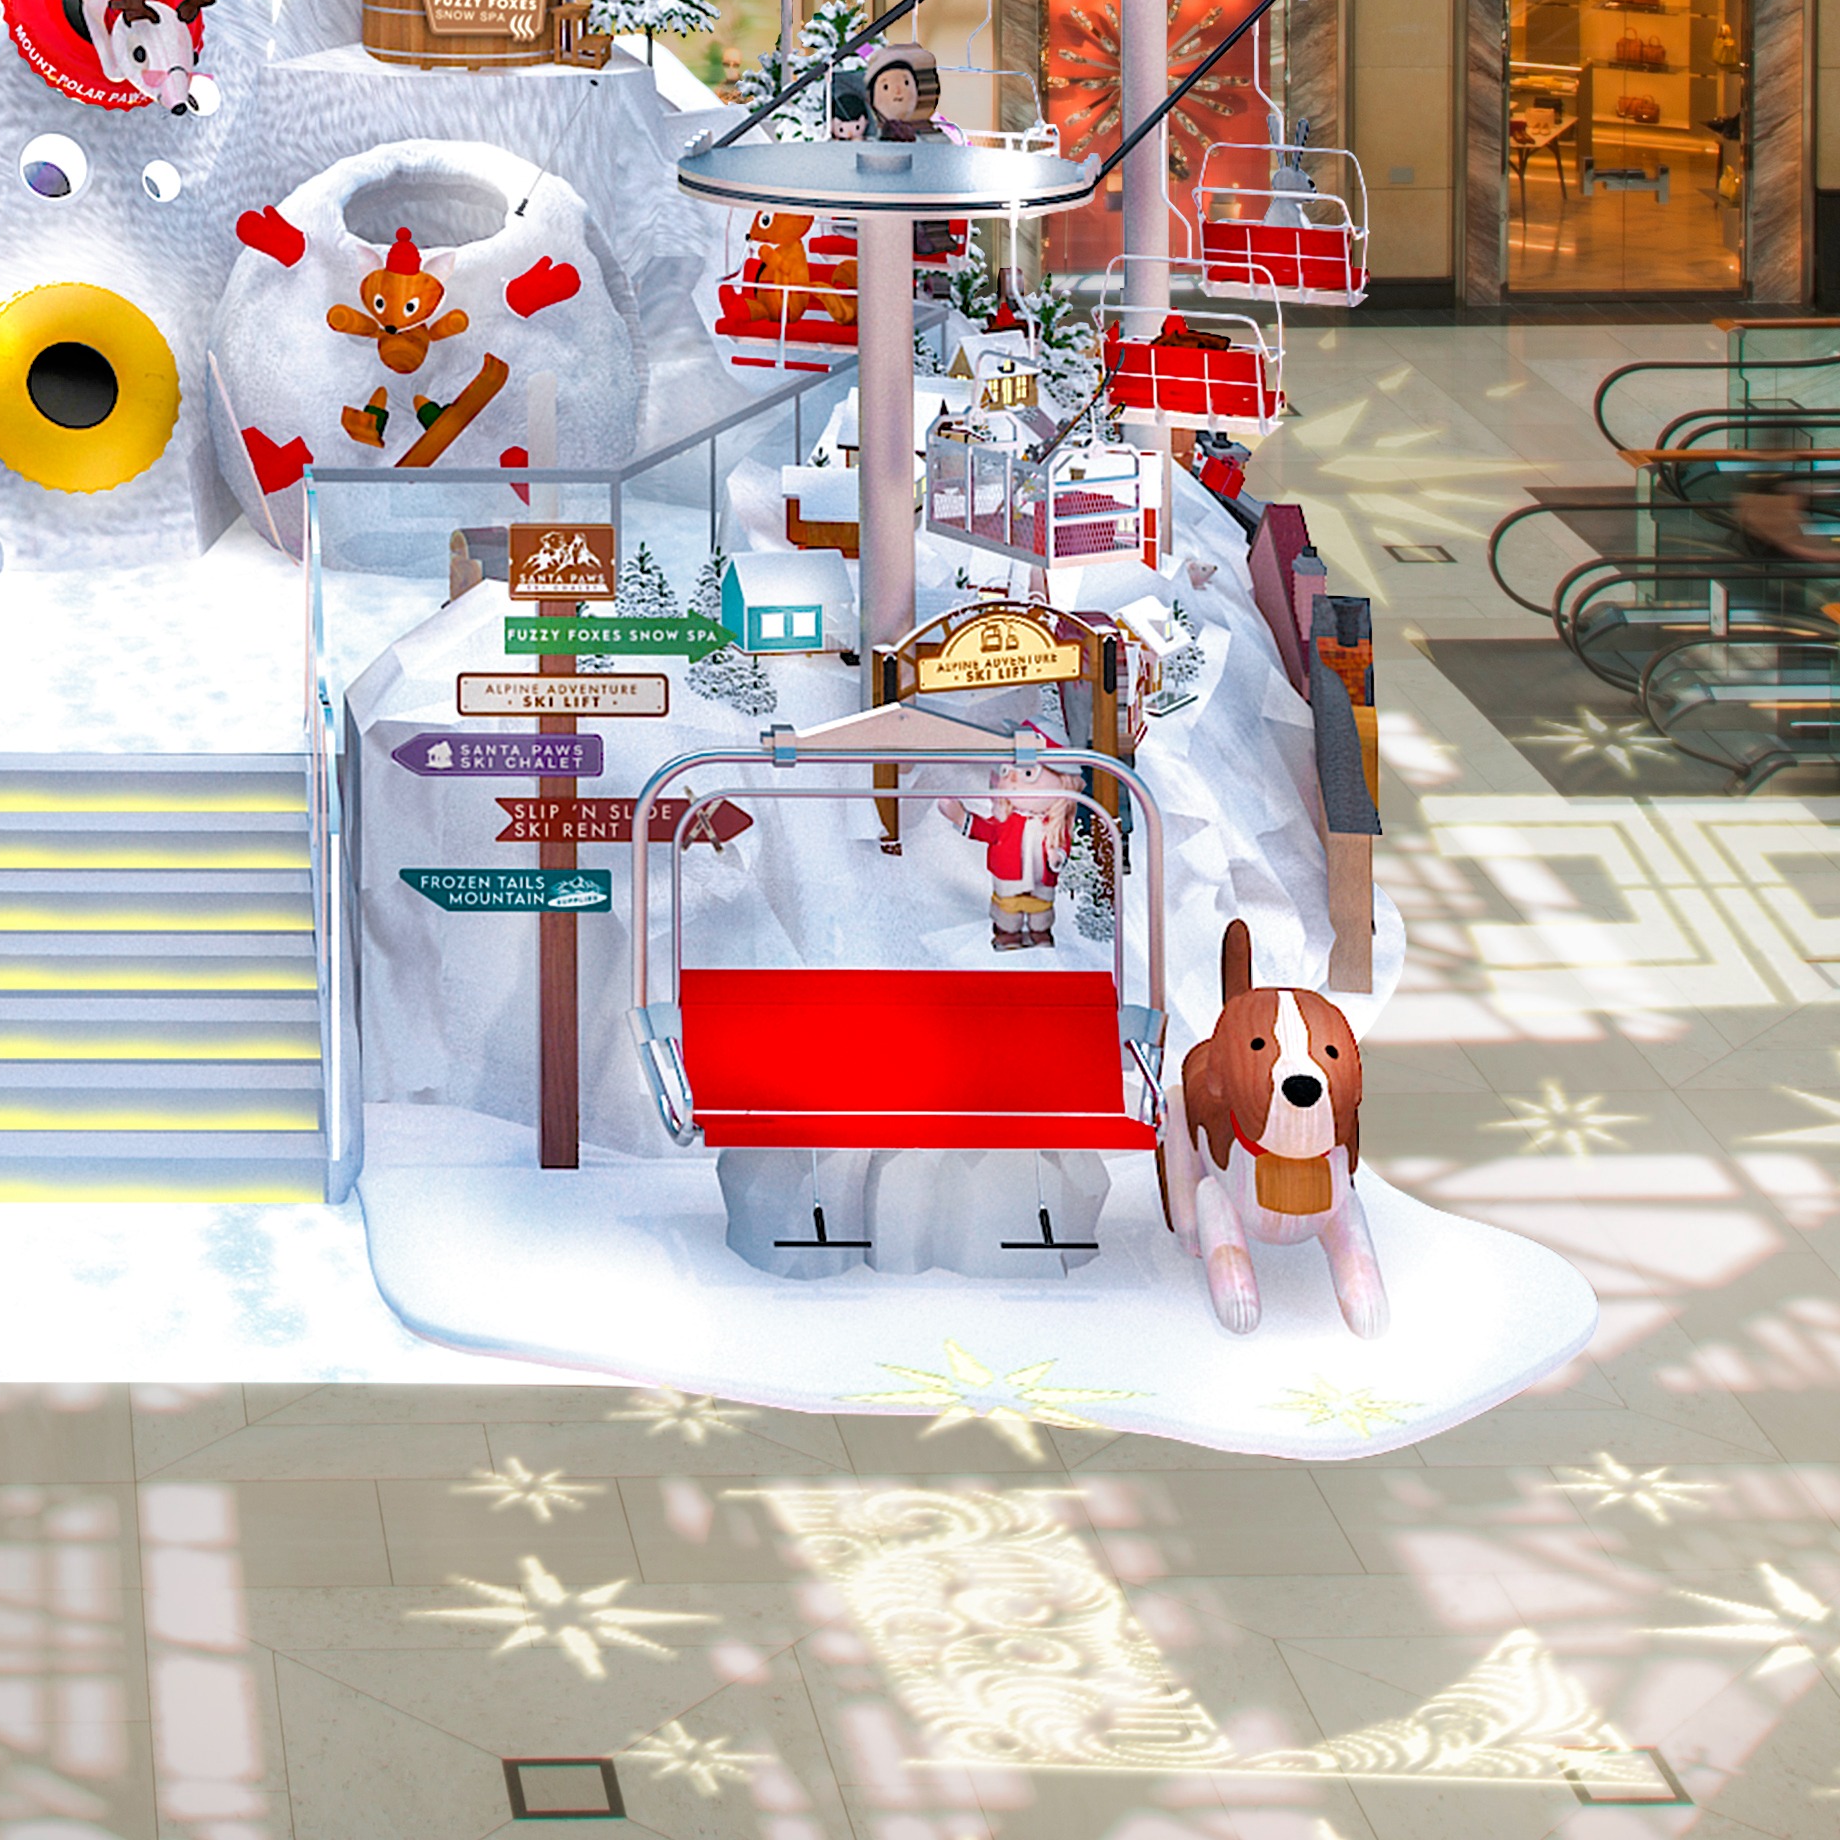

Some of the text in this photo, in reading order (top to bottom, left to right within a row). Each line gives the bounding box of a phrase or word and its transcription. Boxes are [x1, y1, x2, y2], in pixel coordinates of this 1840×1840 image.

[435, 9, 506, 22] SNOW SPA
[15, 24, 58, 76] MOUNT
[57, 73, 106, 101] POLAR
[519, 573, 605, 584] SANTA PAWS
[507, 629, 718, 642] FUZZY FOXES SNOW SPA
[936, 654, 1058, 673] ALPINE ADVENTURE
[966, 666, 1028, 682] SKI LIFT
[486, 684, 638, 696] ALPINE ADVENTURE
[522, 697, 601, 709] SKI LIFT
[460, 744, 584, 756] SANTA PAWS
[460, 757, 584, 769] SKI CHALET
[514, 804, 560, 820] SLIP
[572, 804, 597, 819] 'N
[514, 822, 620, 837] SKI RENT
[420, 875, 545, 890] FROZEN TAILS
[449, 892, 545, 905] MOUNTAIN
